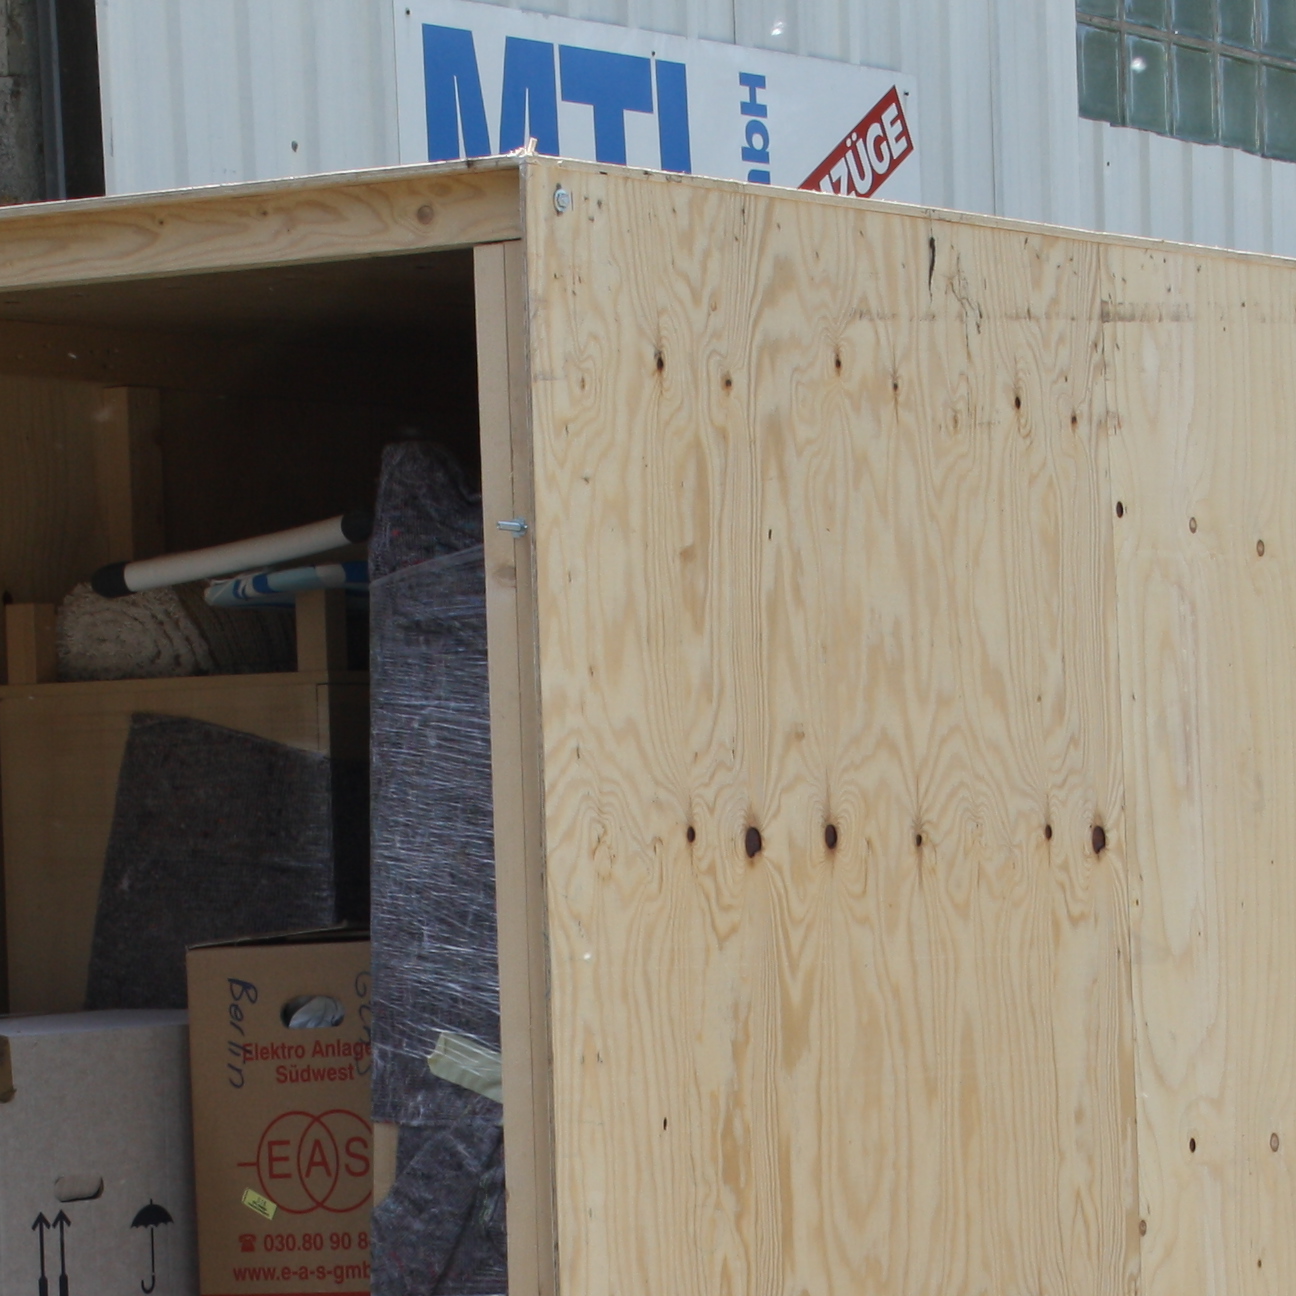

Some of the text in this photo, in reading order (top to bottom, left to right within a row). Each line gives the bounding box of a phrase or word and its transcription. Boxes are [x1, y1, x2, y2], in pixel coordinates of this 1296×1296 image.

[819, 102, 908, 197] ZÜGE
[242, 1040, 306, 1062] Elektro
[275, 1062, 355, 1084] Südwest
[267, 1136, 371, 1179] EAS
[264, 1231, 371, 1252] 030.80 90 8
